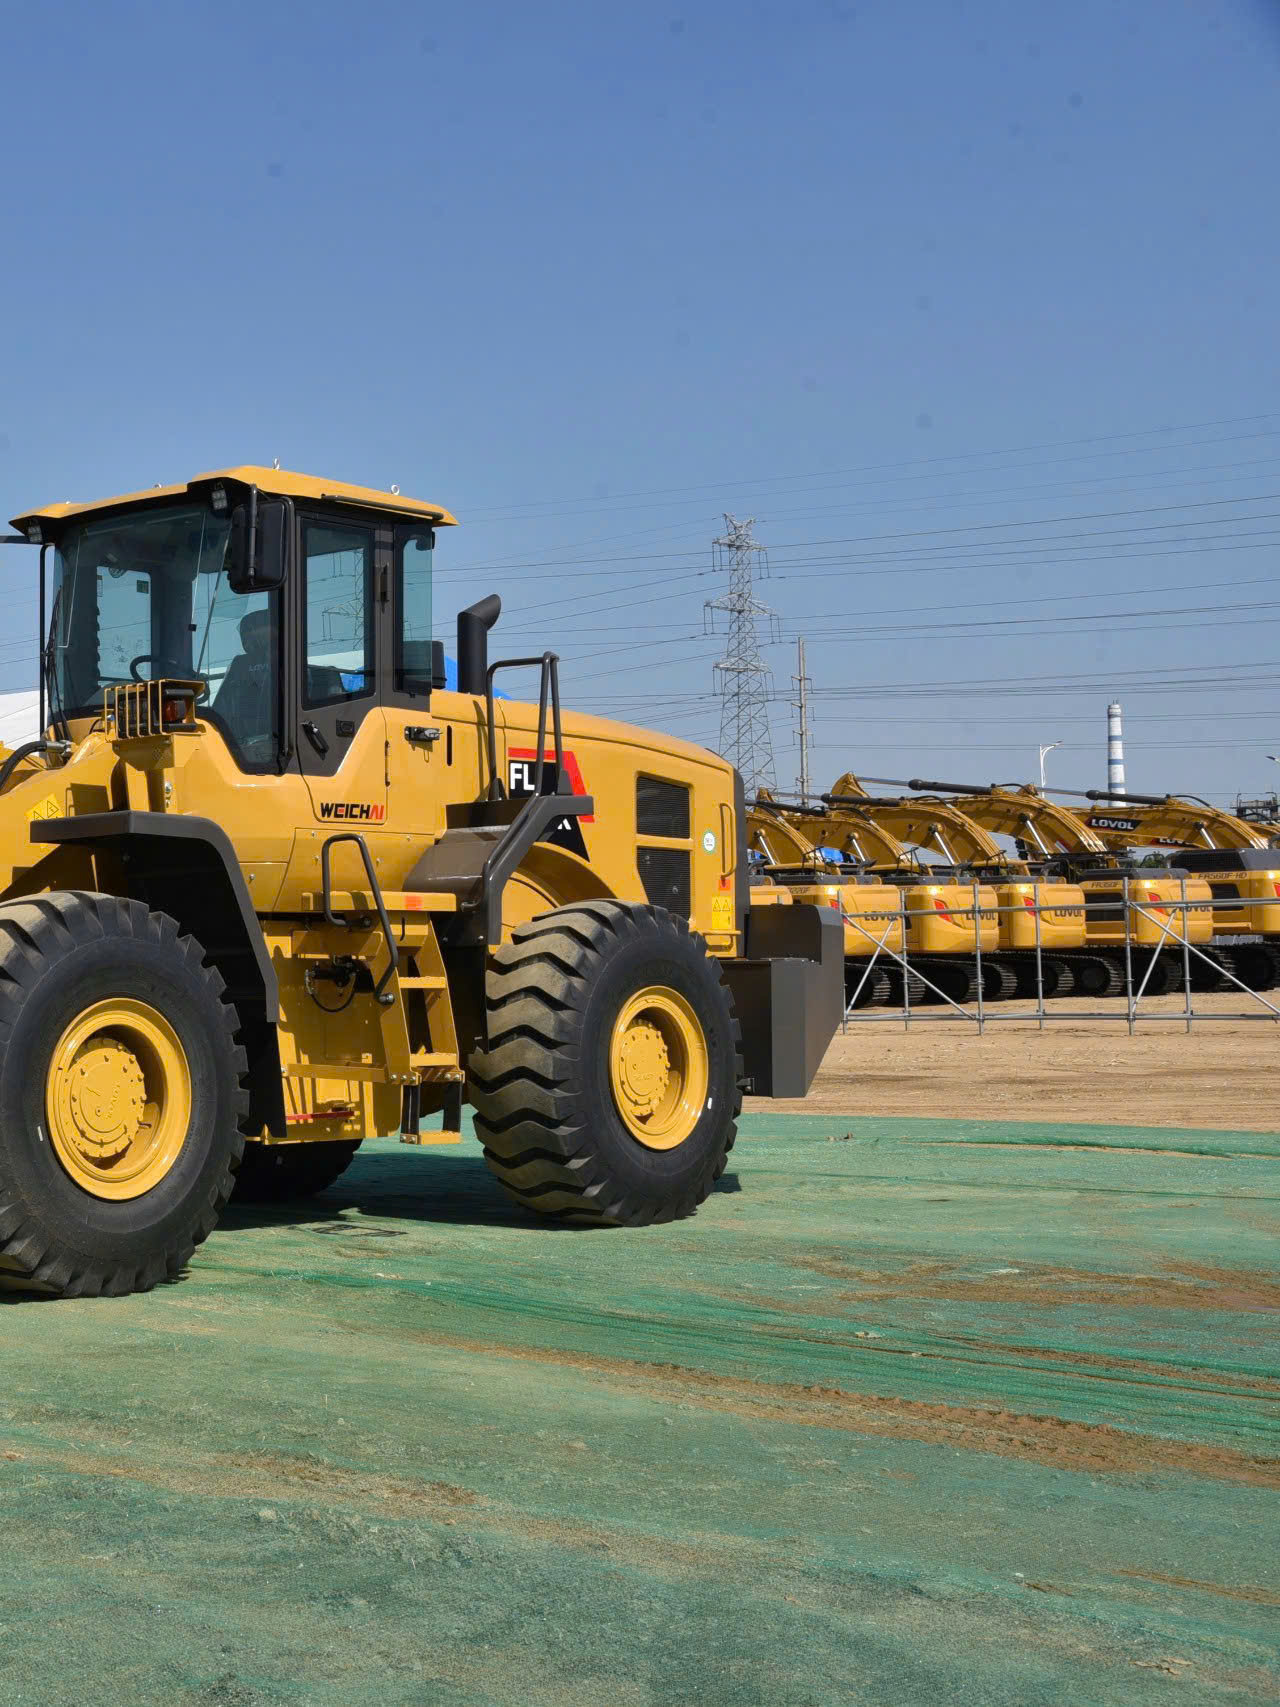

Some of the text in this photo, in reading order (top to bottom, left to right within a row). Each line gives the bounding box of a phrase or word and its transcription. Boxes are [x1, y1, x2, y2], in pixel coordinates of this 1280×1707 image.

[510, 763, 535, 790] FL
[320, 802, 384, 820] WEICHAI
[1091, 818, 1134, 830] LOVOL
